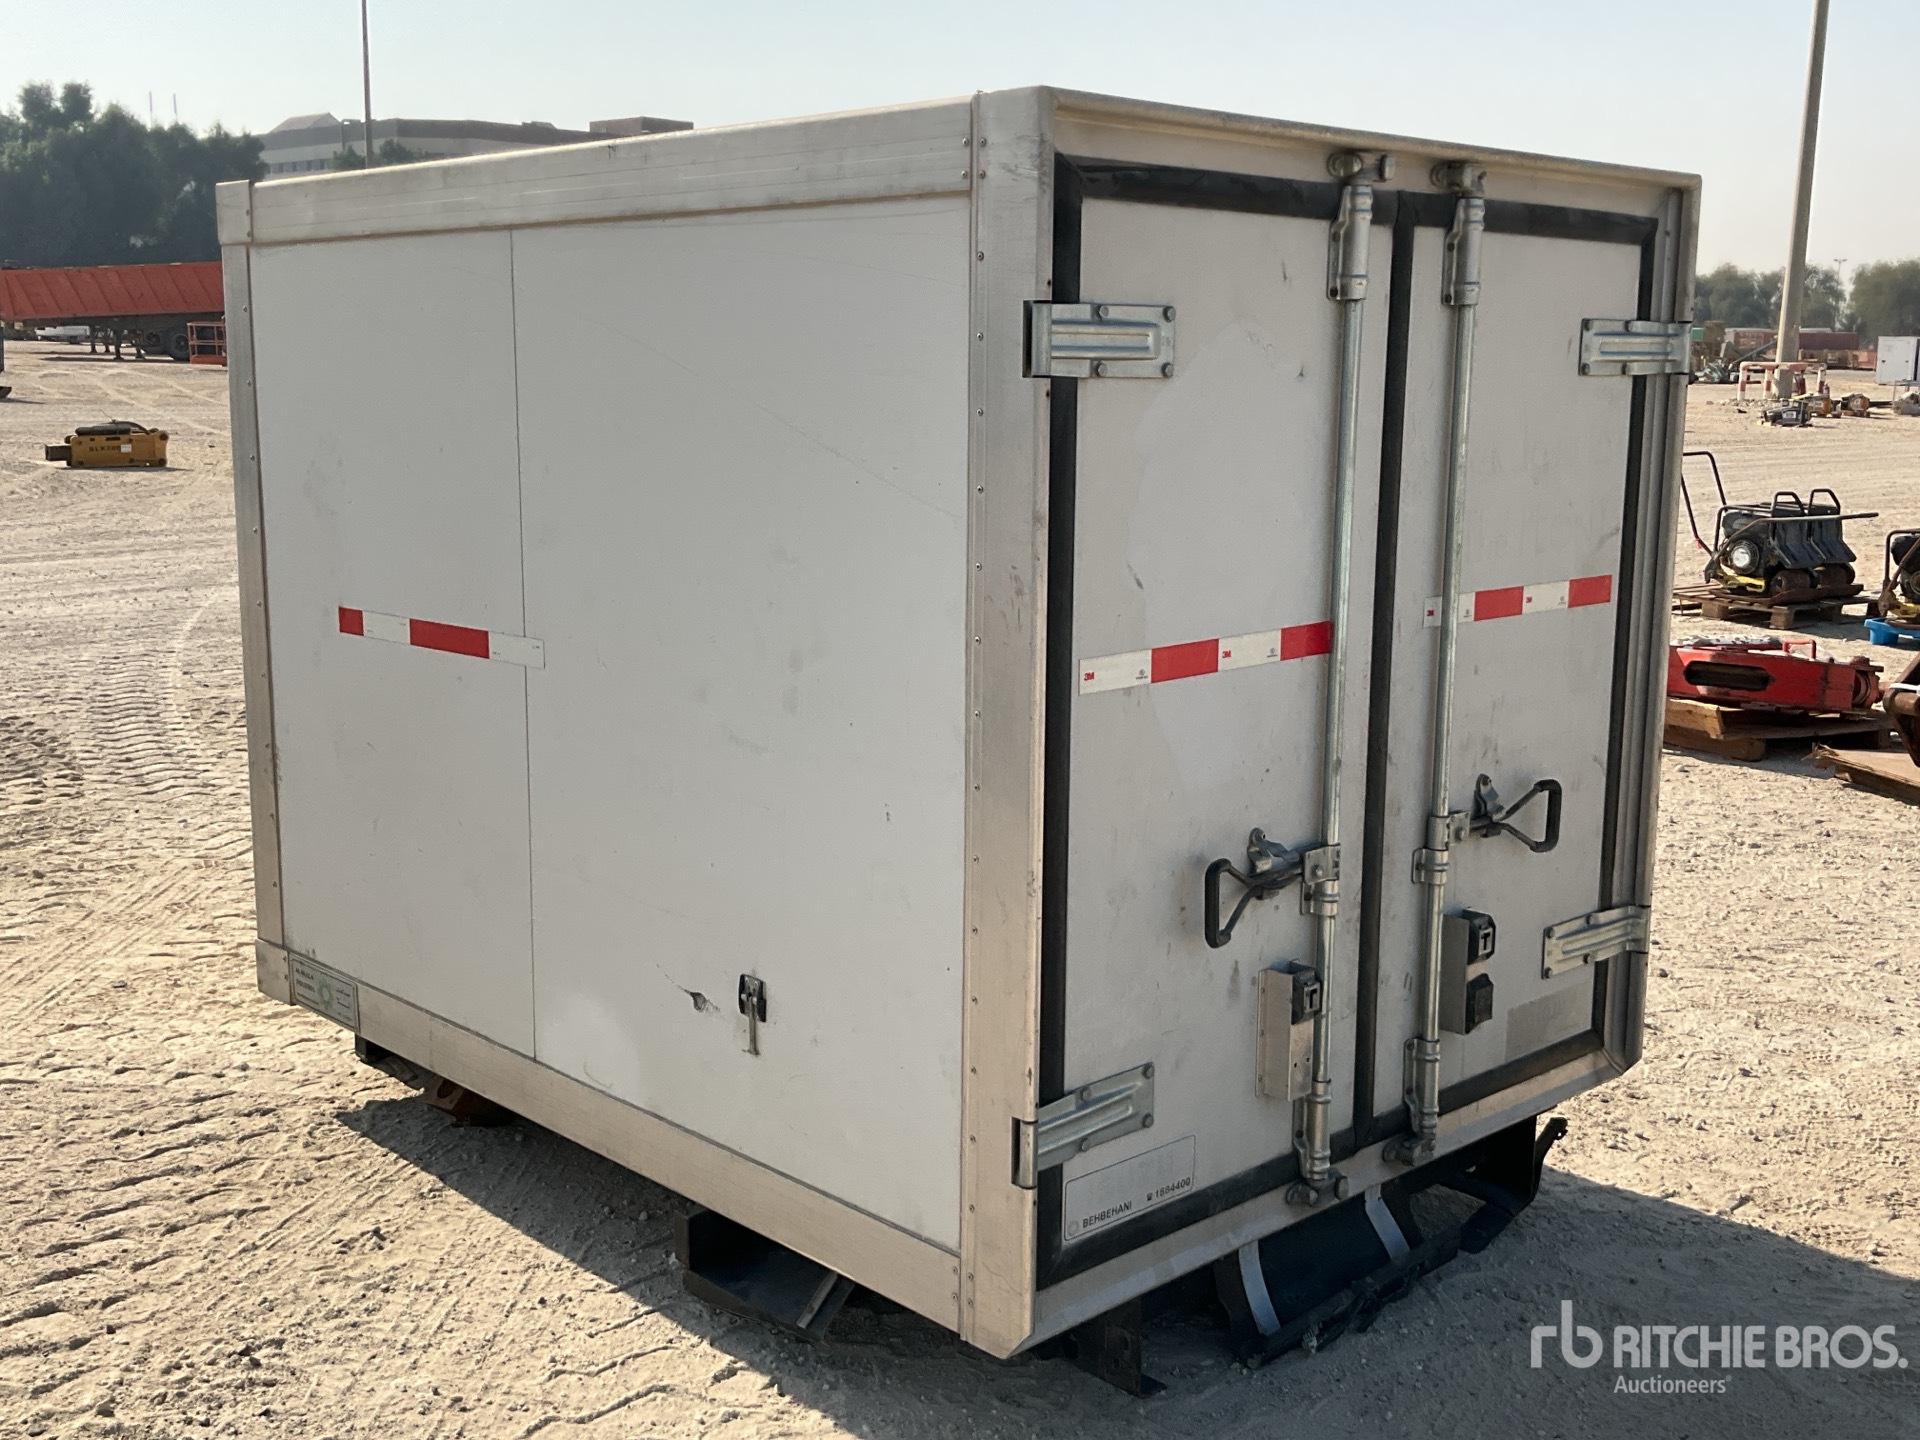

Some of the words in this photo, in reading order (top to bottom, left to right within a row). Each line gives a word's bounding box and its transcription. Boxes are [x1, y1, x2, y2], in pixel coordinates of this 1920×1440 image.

[1222, 650, 1232, 658] 3M
[1084, 672, 1095, 681] 3M
[1082, 1200, 1132, 1228] BEHBEHANI
